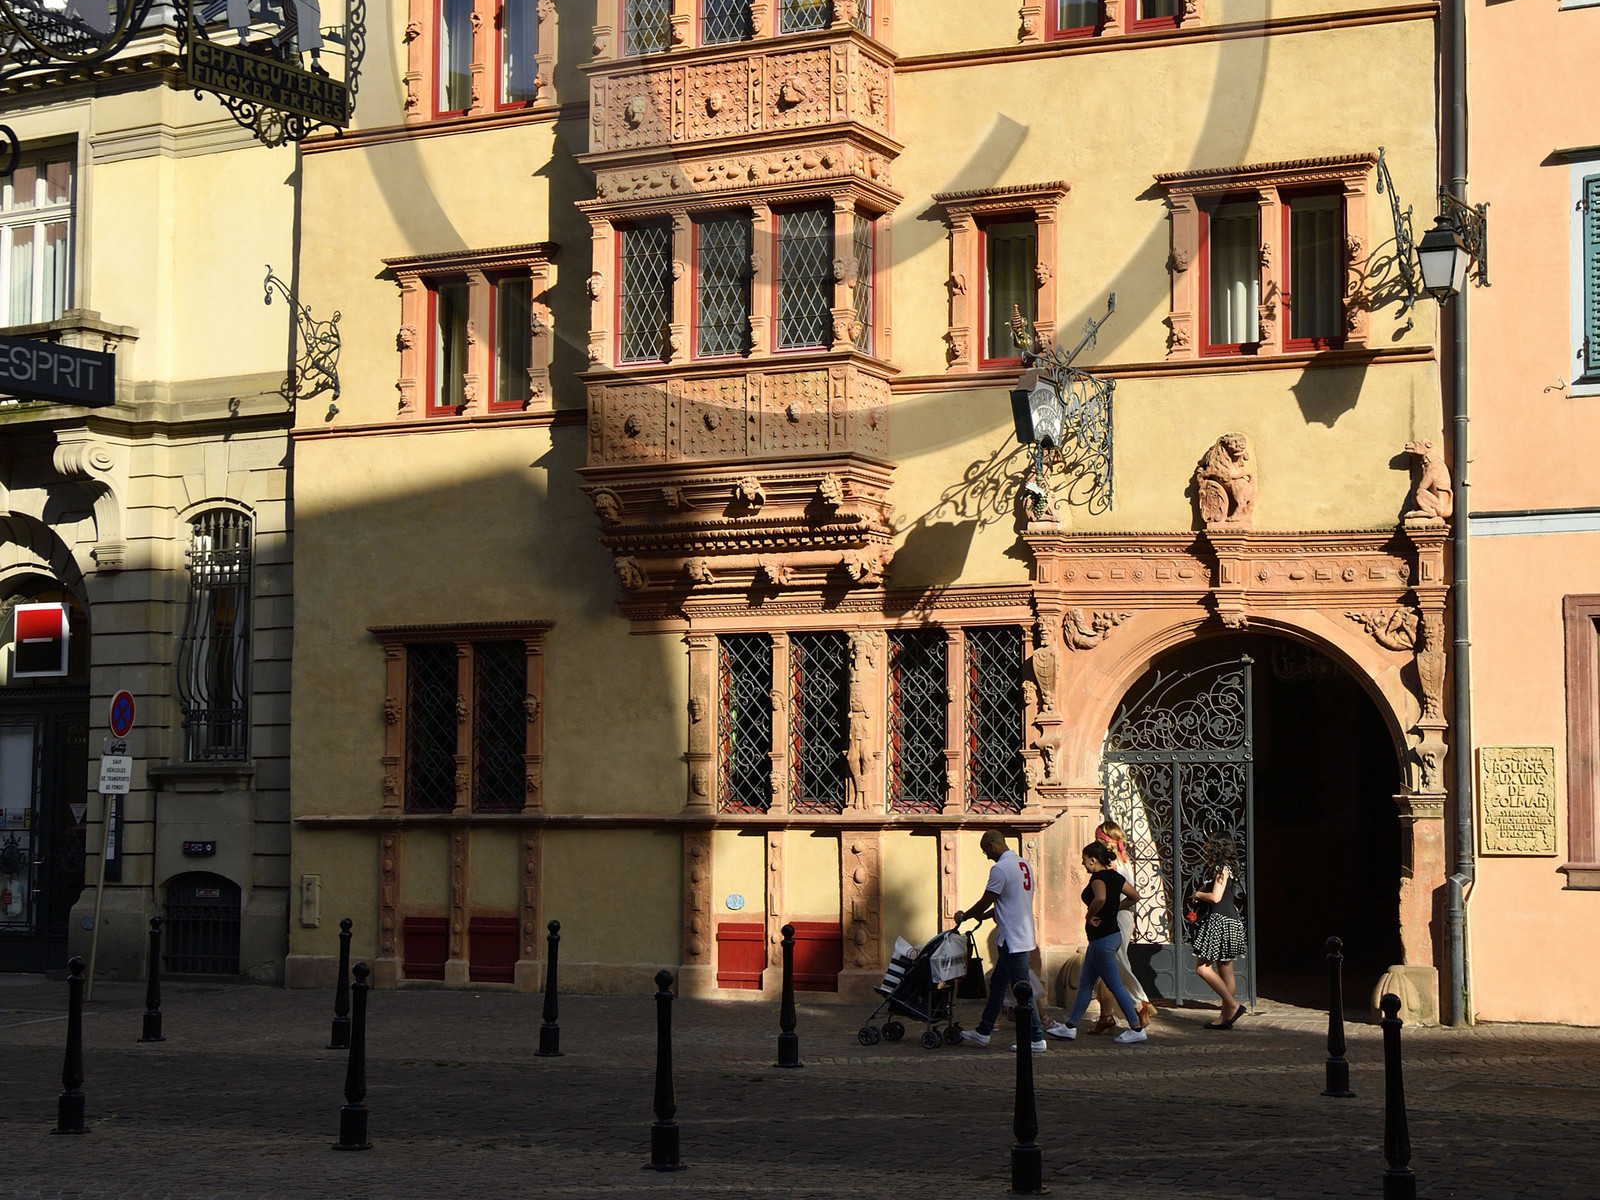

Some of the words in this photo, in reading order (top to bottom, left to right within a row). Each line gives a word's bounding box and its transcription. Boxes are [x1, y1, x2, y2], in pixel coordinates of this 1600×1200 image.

[194, 44, 341, 102] CHARCUTERIE
[194, 63, 273, 102] FINCKER
[280, 86, 345, 121] FRERES
[0, 344, 102, 391] ESPRIT
[1493, 761, 1542, 774] BOURSE
[1491, 774, 1516, 785] AUX
[1518, 774, 1546, 785] VINS
[1508, 785, 1526, 797] DE
[1491, 796, 1547, 808] COLMAR
[1018, 861, 1032, 891] 3
